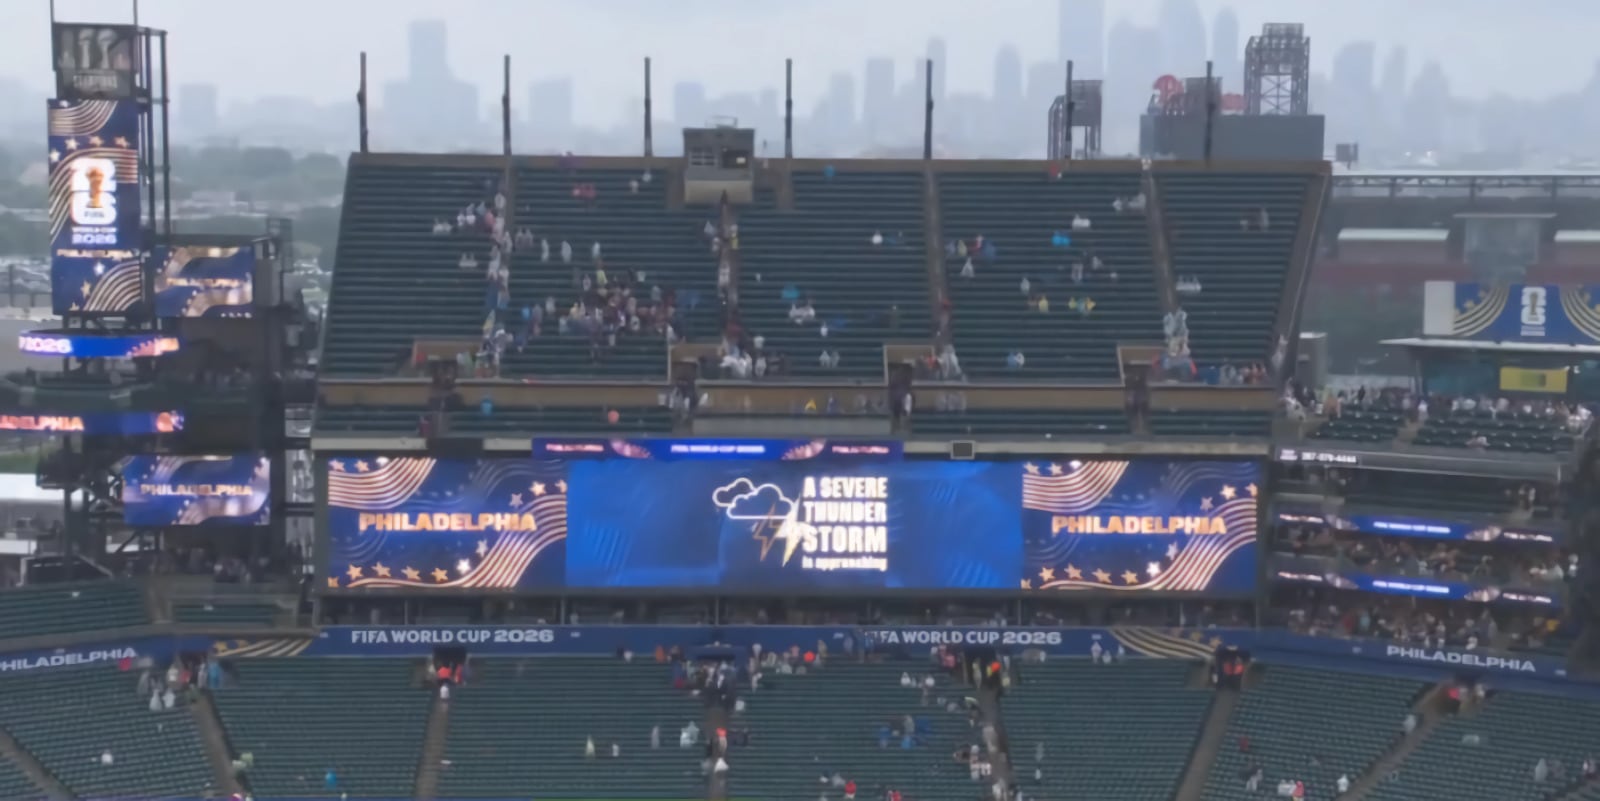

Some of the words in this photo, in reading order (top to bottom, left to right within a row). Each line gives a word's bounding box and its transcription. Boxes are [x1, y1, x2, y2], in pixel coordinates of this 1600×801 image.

[140, 483, 253, 496] PHILADELPHIA
[803, 476, 816, 498] A
[820, 476, 888, 498] SEVERE
[359, 513, 537, 531] PHILADELPHIA
[803, 501, 887, 523] THUNDER
[1052, 515, 1227, 534] PHILADELPHIA
[802, 524, 887, 553] STORM
[351, 630, 388, 643] FIFA
[391, 630, 454, 643] WORLD
[457, 630, 491, 643] CUP
[494, 629, 554, 643] 2026
[902, 630, 963, 644] WORLD
[966, 631, 999, 644] CUP
[1003, 631, 1062, 645] 2026
[0, 647, 137, 671] HILADELPHIA
[1387, 644, 1536, 672] PHILADELPHIA
